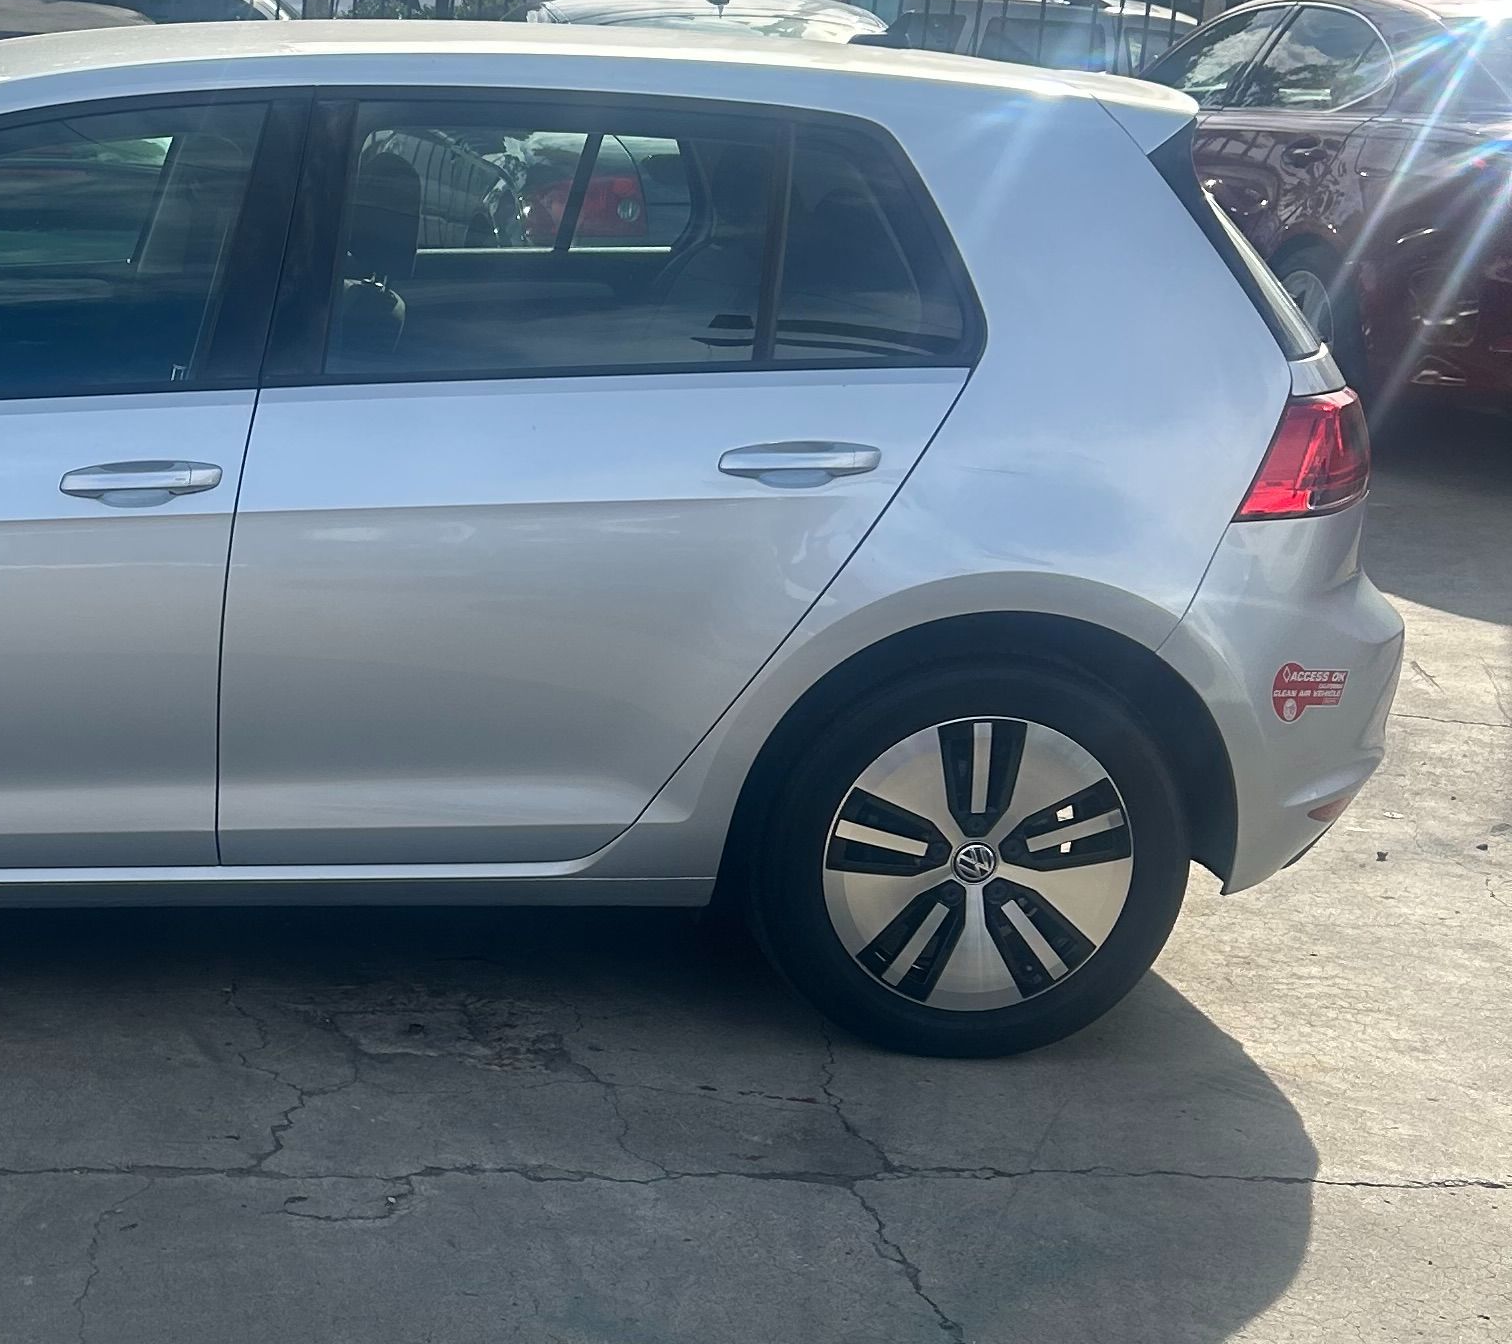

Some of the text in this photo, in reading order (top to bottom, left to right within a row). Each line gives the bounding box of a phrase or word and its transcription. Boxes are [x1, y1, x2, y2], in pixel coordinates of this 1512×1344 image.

[1290, 671, 1347, 682] ACCESS OK
[1273, 689, 1298, 697] CLEAN
